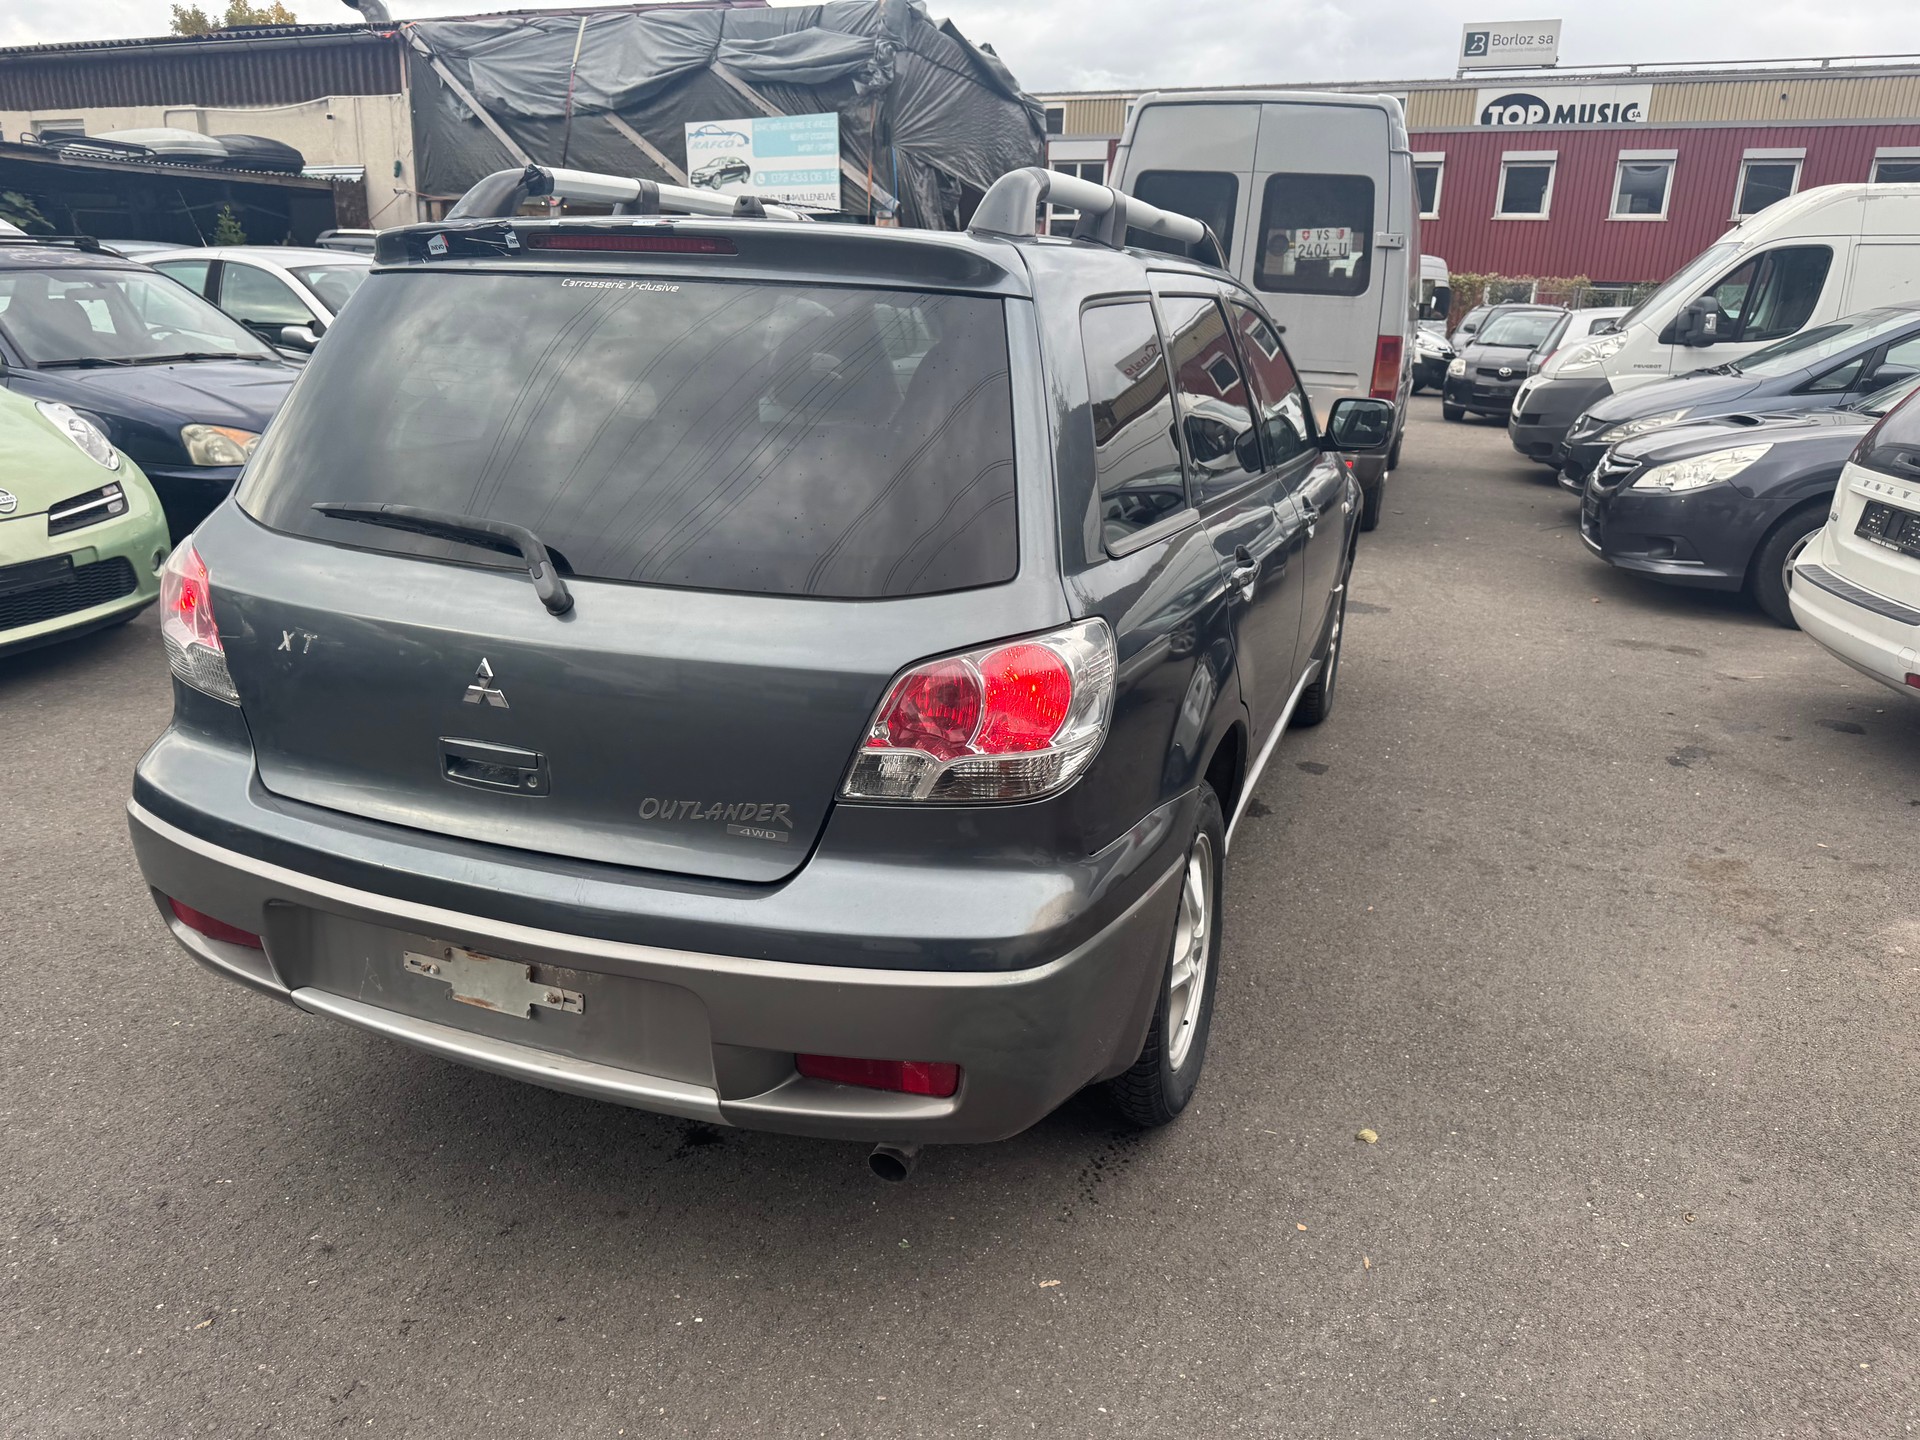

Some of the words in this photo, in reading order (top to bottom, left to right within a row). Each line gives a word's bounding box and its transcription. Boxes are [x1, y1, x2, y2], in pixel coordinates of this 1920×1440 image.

[1492, 33, 1534, 46] Borloz
[1538, 35, 1554, 45] sa
[1488, 104, 1544, 125] TOP
[1552, 102, 1638, 124] MUSIC
[1631, 110, 1642, 118] SA
[691, 139, 735, 150] RAFCO
[1316, 229, 1330, 240] VS
[561, 278, 627, 290] Carrosserie
[628, 281, 680, 293] X-clusive
[638, 797, 794, 829] OUTLANDER
[739, 828, 777, 840] 4WD
